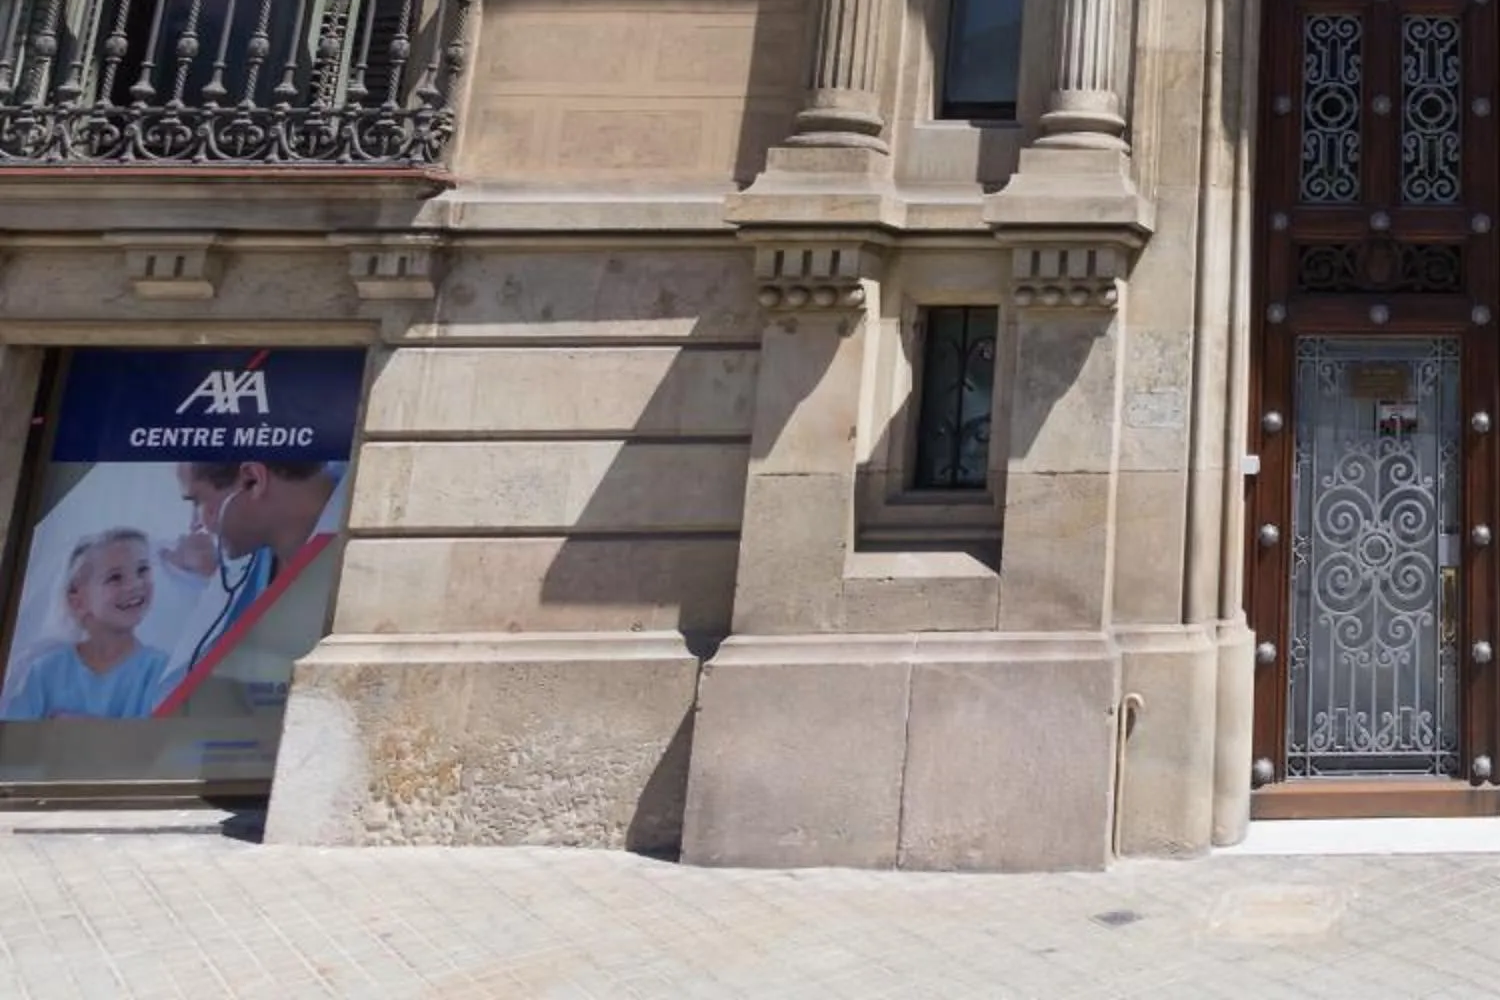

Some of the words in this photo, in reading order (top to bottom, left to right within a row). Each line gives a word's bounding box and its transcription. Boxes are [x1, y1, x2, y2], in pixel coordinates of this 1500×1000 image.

[175, 369, 270, 415] AXA
[129, 427, 226, 447] CENTRE
[232, 422, 315, 447] MÈDIC
